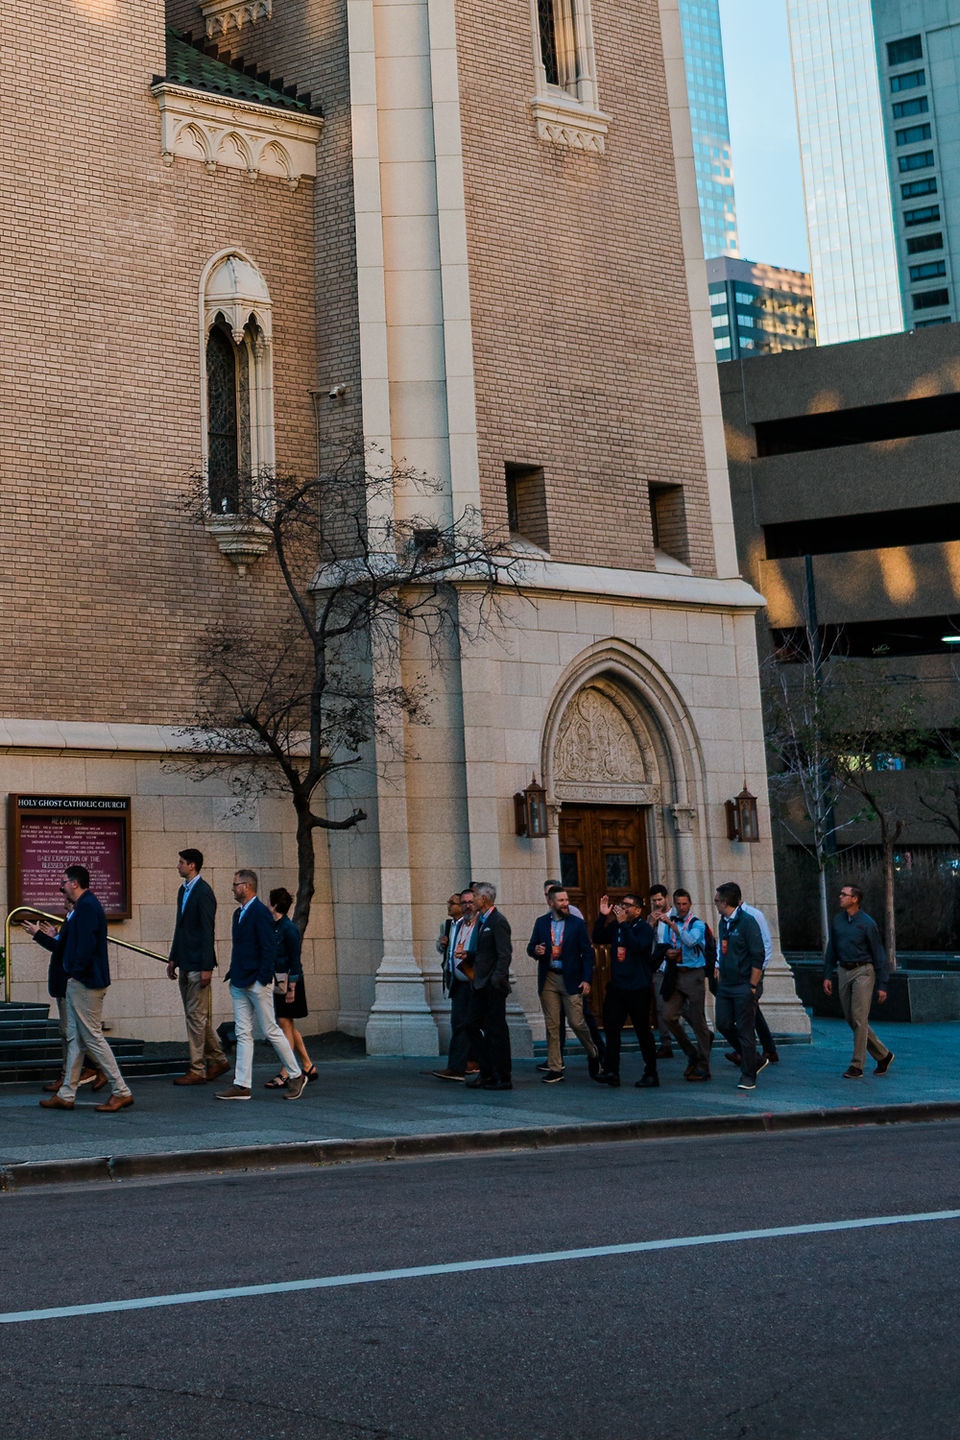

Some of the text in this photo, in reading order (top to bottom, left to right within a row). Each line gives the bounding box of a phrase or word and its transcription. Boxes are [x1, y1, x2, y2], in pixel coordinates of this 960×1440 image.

[38, 799, 62, 807] GHOST
[63, 800, 97, 808] CATHOLIC
[97, 801, 126, 809] CHURCH
